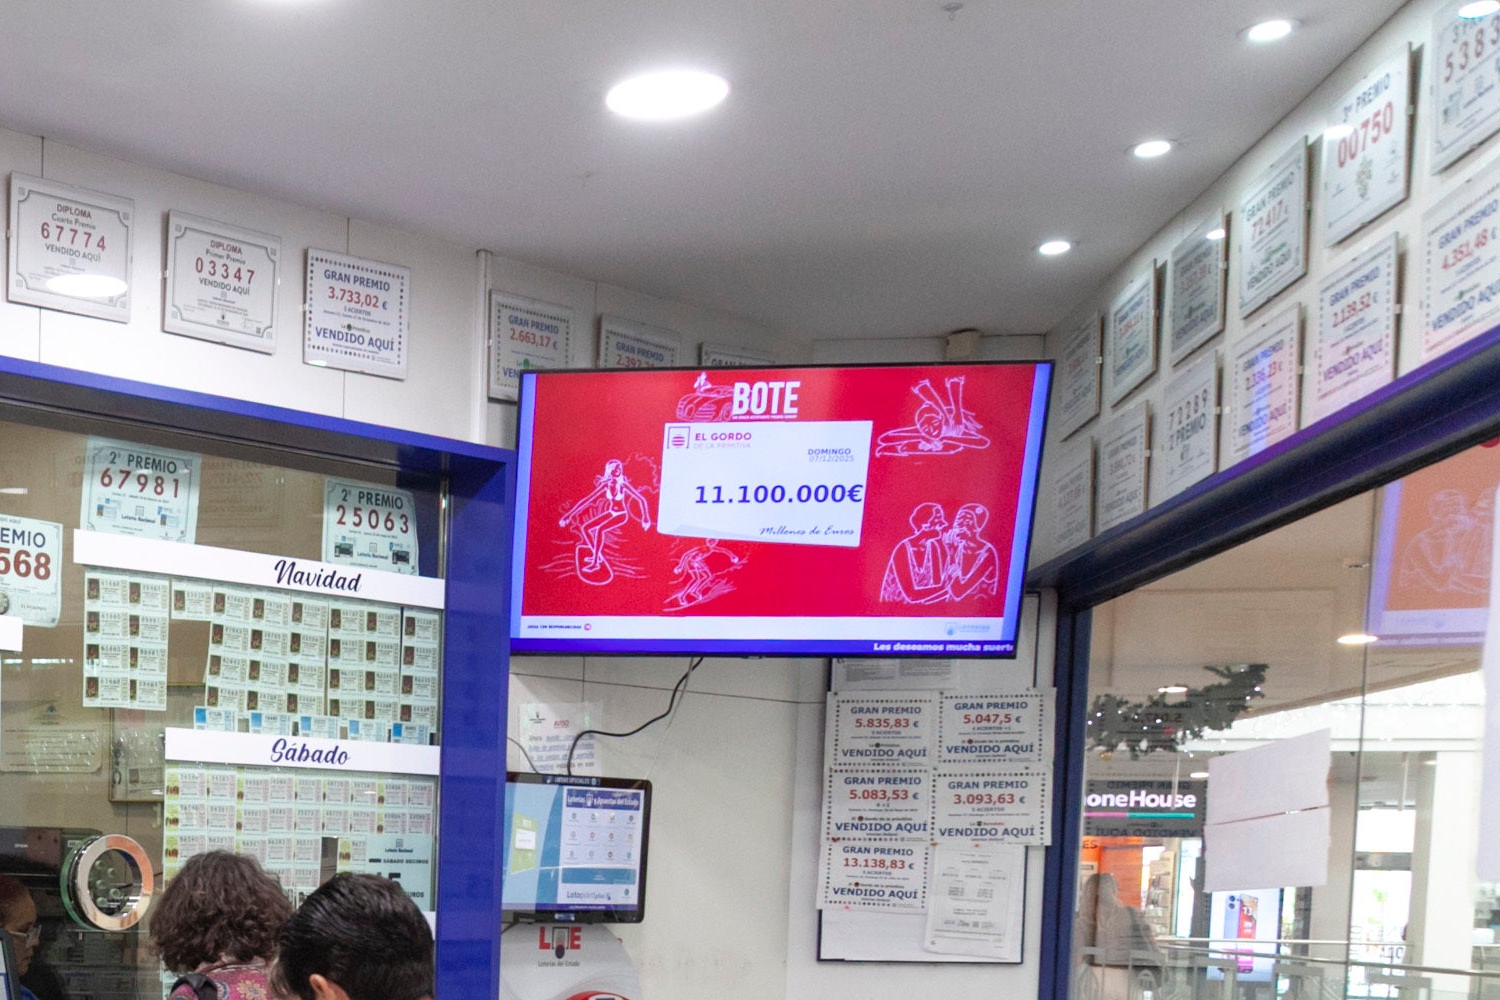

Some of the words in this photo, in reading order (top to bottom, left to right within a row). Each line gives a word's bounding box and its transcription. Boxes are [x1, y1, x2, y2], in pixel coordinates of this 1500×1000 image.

[1337, 101, 1394, 168] 00750
[57, 203, 92, 219] DIPLOMA
[52, 213, 73, 225] Cuarto
[74, 218, 96, 230] Premio
[40, 222, 107, 252] 67774
[45, 242, 80, 257] VENDIDO
[210, 240, 242, 254] DIPLOMA
[195, 257, 255, 284] 03347
[199, 277, 231, 291] VENDIDO
[324, 269, 350, 283] GRAN
[353, 275, 390, 292] PREMIO
[328, 286, 379, 308] 3.733,02
[508, 315, 529, 328] GRAN
[531, 320, 559, 334] PREMIO
[315, 326, 365, 345] VENDIDO
[367, 337, 395, 351] AQUÍ
[509, 327, 551, 347] 2.663,17
[732, 381, 801, 415] BOTE
[695, 433, 707, 441] EL
[711, 432, 752, 441] GORDO
[127, 453, 177, 474] PREMIO
[100, 467, 179, 498] 67981
[358, 491, 403, 509] PREMIO
[695, 484, 863, 504] 11.100.000€
[336, 504, 409, 533] 25063
[809, 525, 821, 535] de
[274, 559, 362, 592] Navidad
[893, 643, 943, 652] deseamos
[946, 643, 981, 652] mucha
[855, 719, 909, 729] 5.835,83
[963, 714, 1011, 725] 5.047,5
[270, 738, 350, 765] Sábado
[842, 749, 894, 757] VENDIDO
[898, 747, 927, 758] AQUÍ
[946, 745, 1000, 753] VENDIDO
[1004, 742, 1034, 754] AQUÍ
[844, 777, 874, 785] GRAN
[879, 777, 921, 785] PREMIO
[948, 781, 979, 789] GRAN
[849, 790, 908, 801] 5.083,53
[954, 794, 1015, 805] 3.093,63
[836, 823, 892, 831] VENDIDO
[895, 821, 927, 833] AQUÍ
[939, 828, 997, 836] VENDIDO
[1002, 826, 1035, 838] AQUÍ
[874, 848, 913, 856] PREMIO
[844, 858, 905, 870] 13.138,83
[833, 888, 885, 898] VENDIDO
[889, 888, 917, 900] AQUÍ
